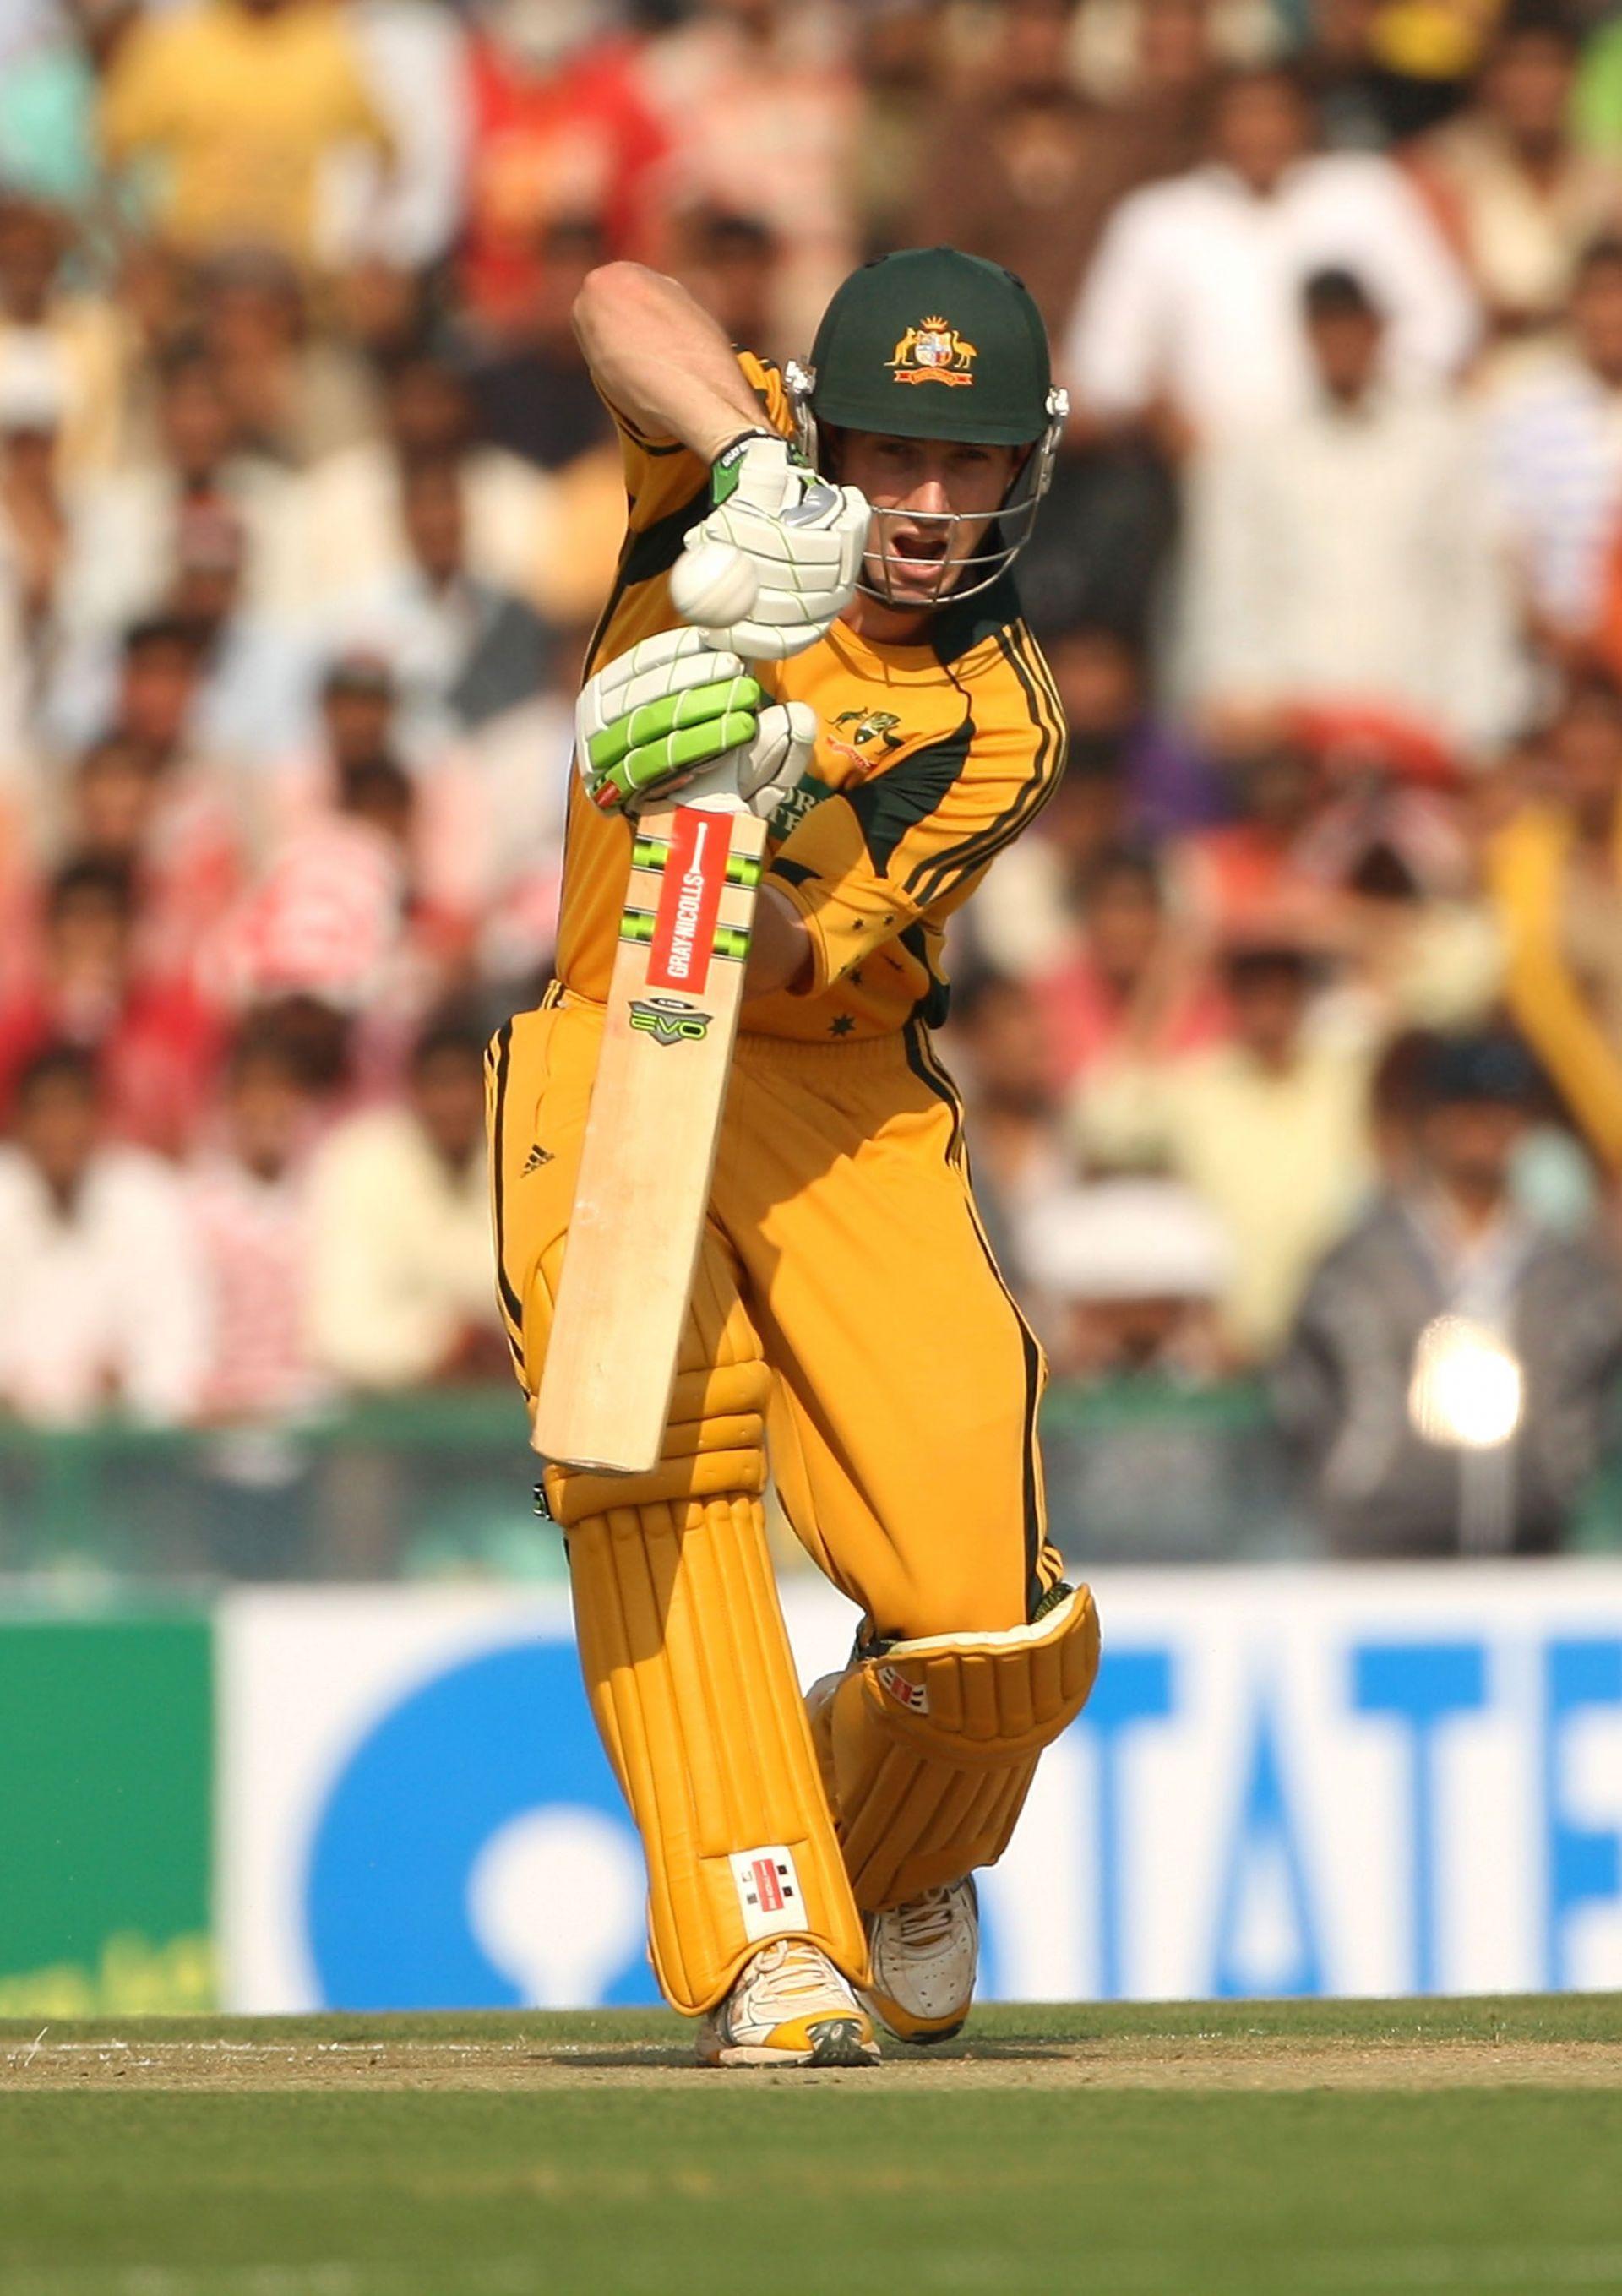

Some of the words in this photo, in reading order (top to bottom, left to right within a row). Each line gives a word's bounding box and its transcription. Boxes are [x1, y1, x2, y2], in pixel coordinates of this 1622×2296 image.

[667, 873, 705, 978] GRAY-NICOLLS
[630, 1011, 706, 1040] EVO
[977, 1637, 1621, 1999] TATE
